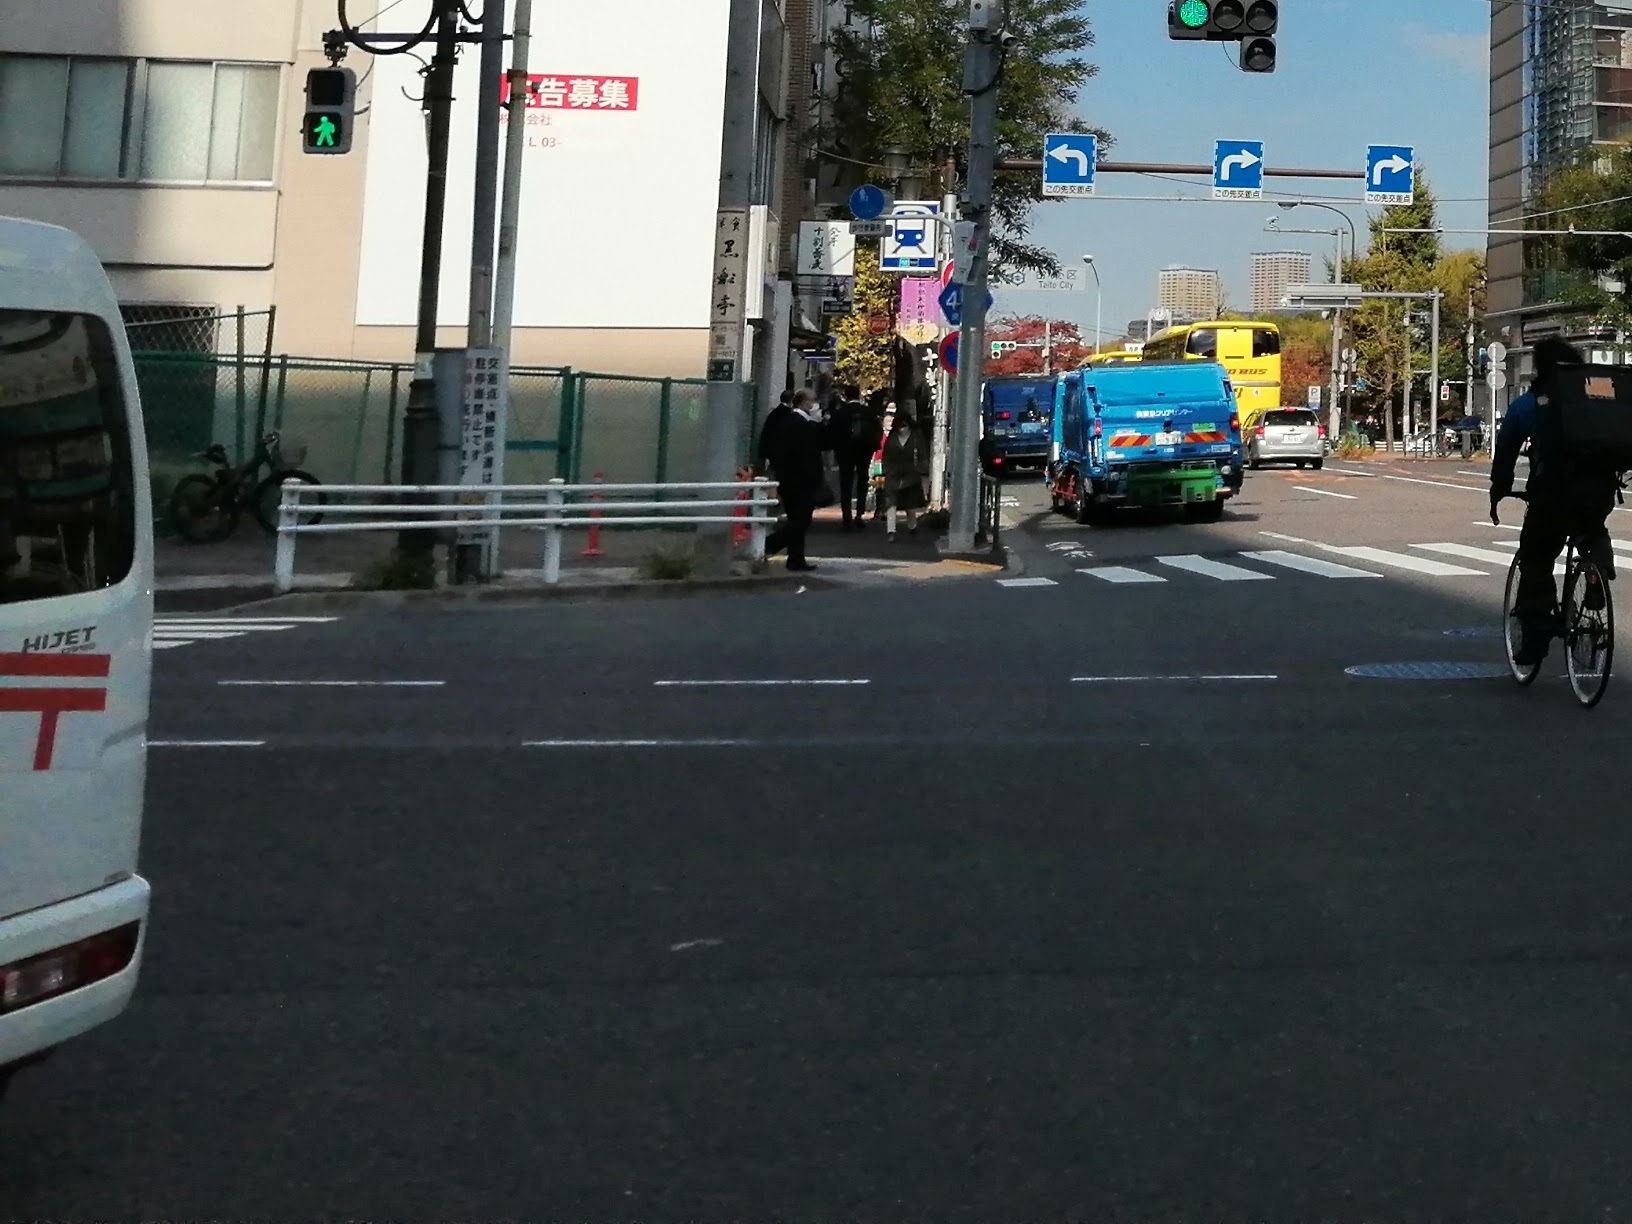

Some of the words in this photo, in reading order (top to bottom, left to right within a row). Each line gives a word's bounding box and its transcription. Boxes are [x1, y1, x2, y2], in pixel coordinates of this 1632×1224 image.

[1045, 185, 1093, 194] この先交差点
[1214, 189, 1260, 198] この先交差点
[1367, 194, 1410, 203] この先交差点
[1060, 281, 1074, 290] City
[21, 625, 98, 654] HIJET
